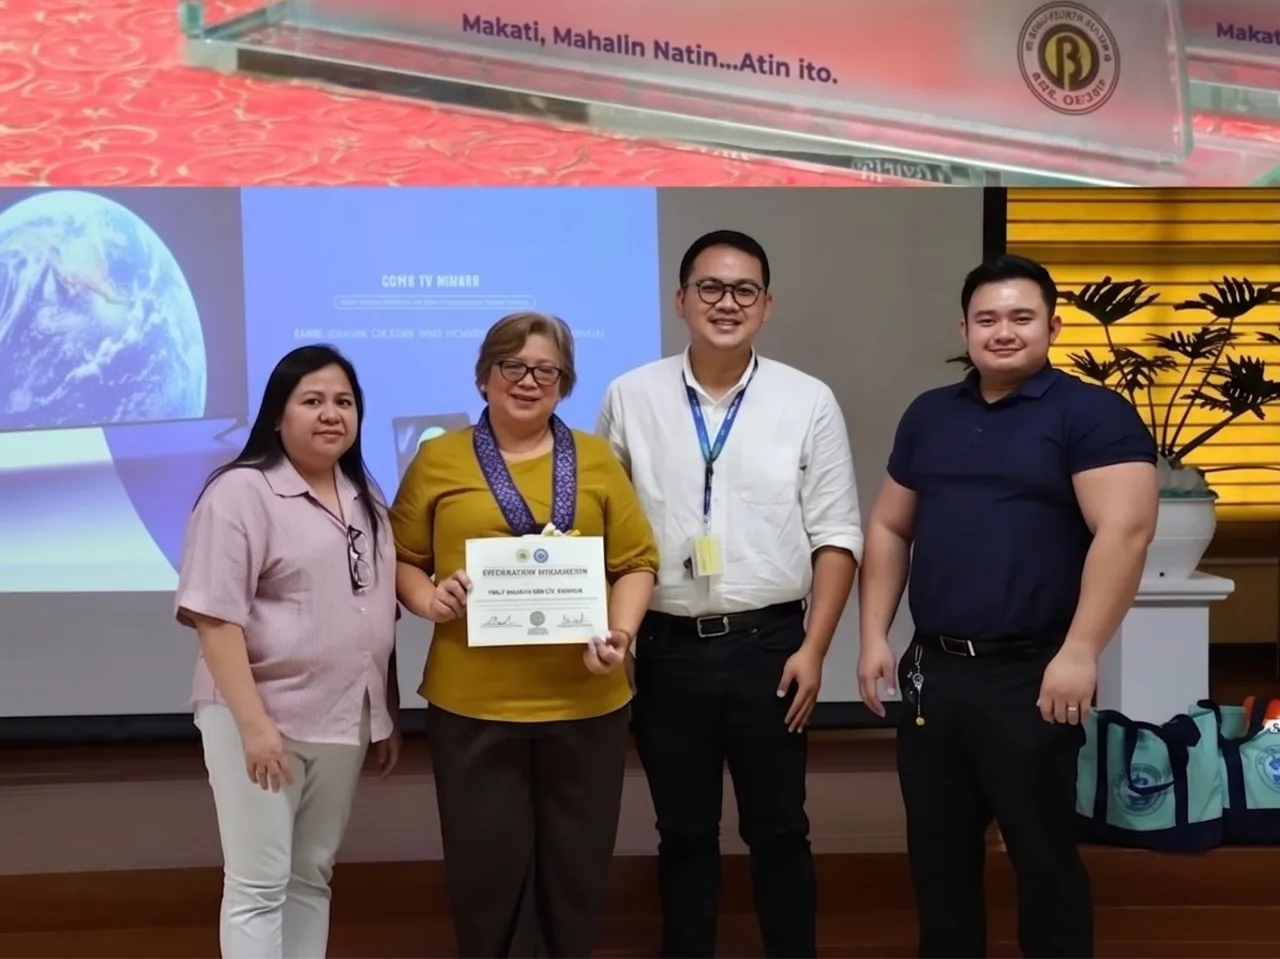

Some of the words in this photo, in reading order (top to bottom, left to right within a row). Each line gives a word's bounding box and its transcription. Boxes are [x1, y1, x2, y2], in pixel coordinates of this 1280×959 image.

[461, 13, 546, 47] Makati,
[552, 26, 645, 58] Mahalin
[798, 56, 839, 84] ito.
